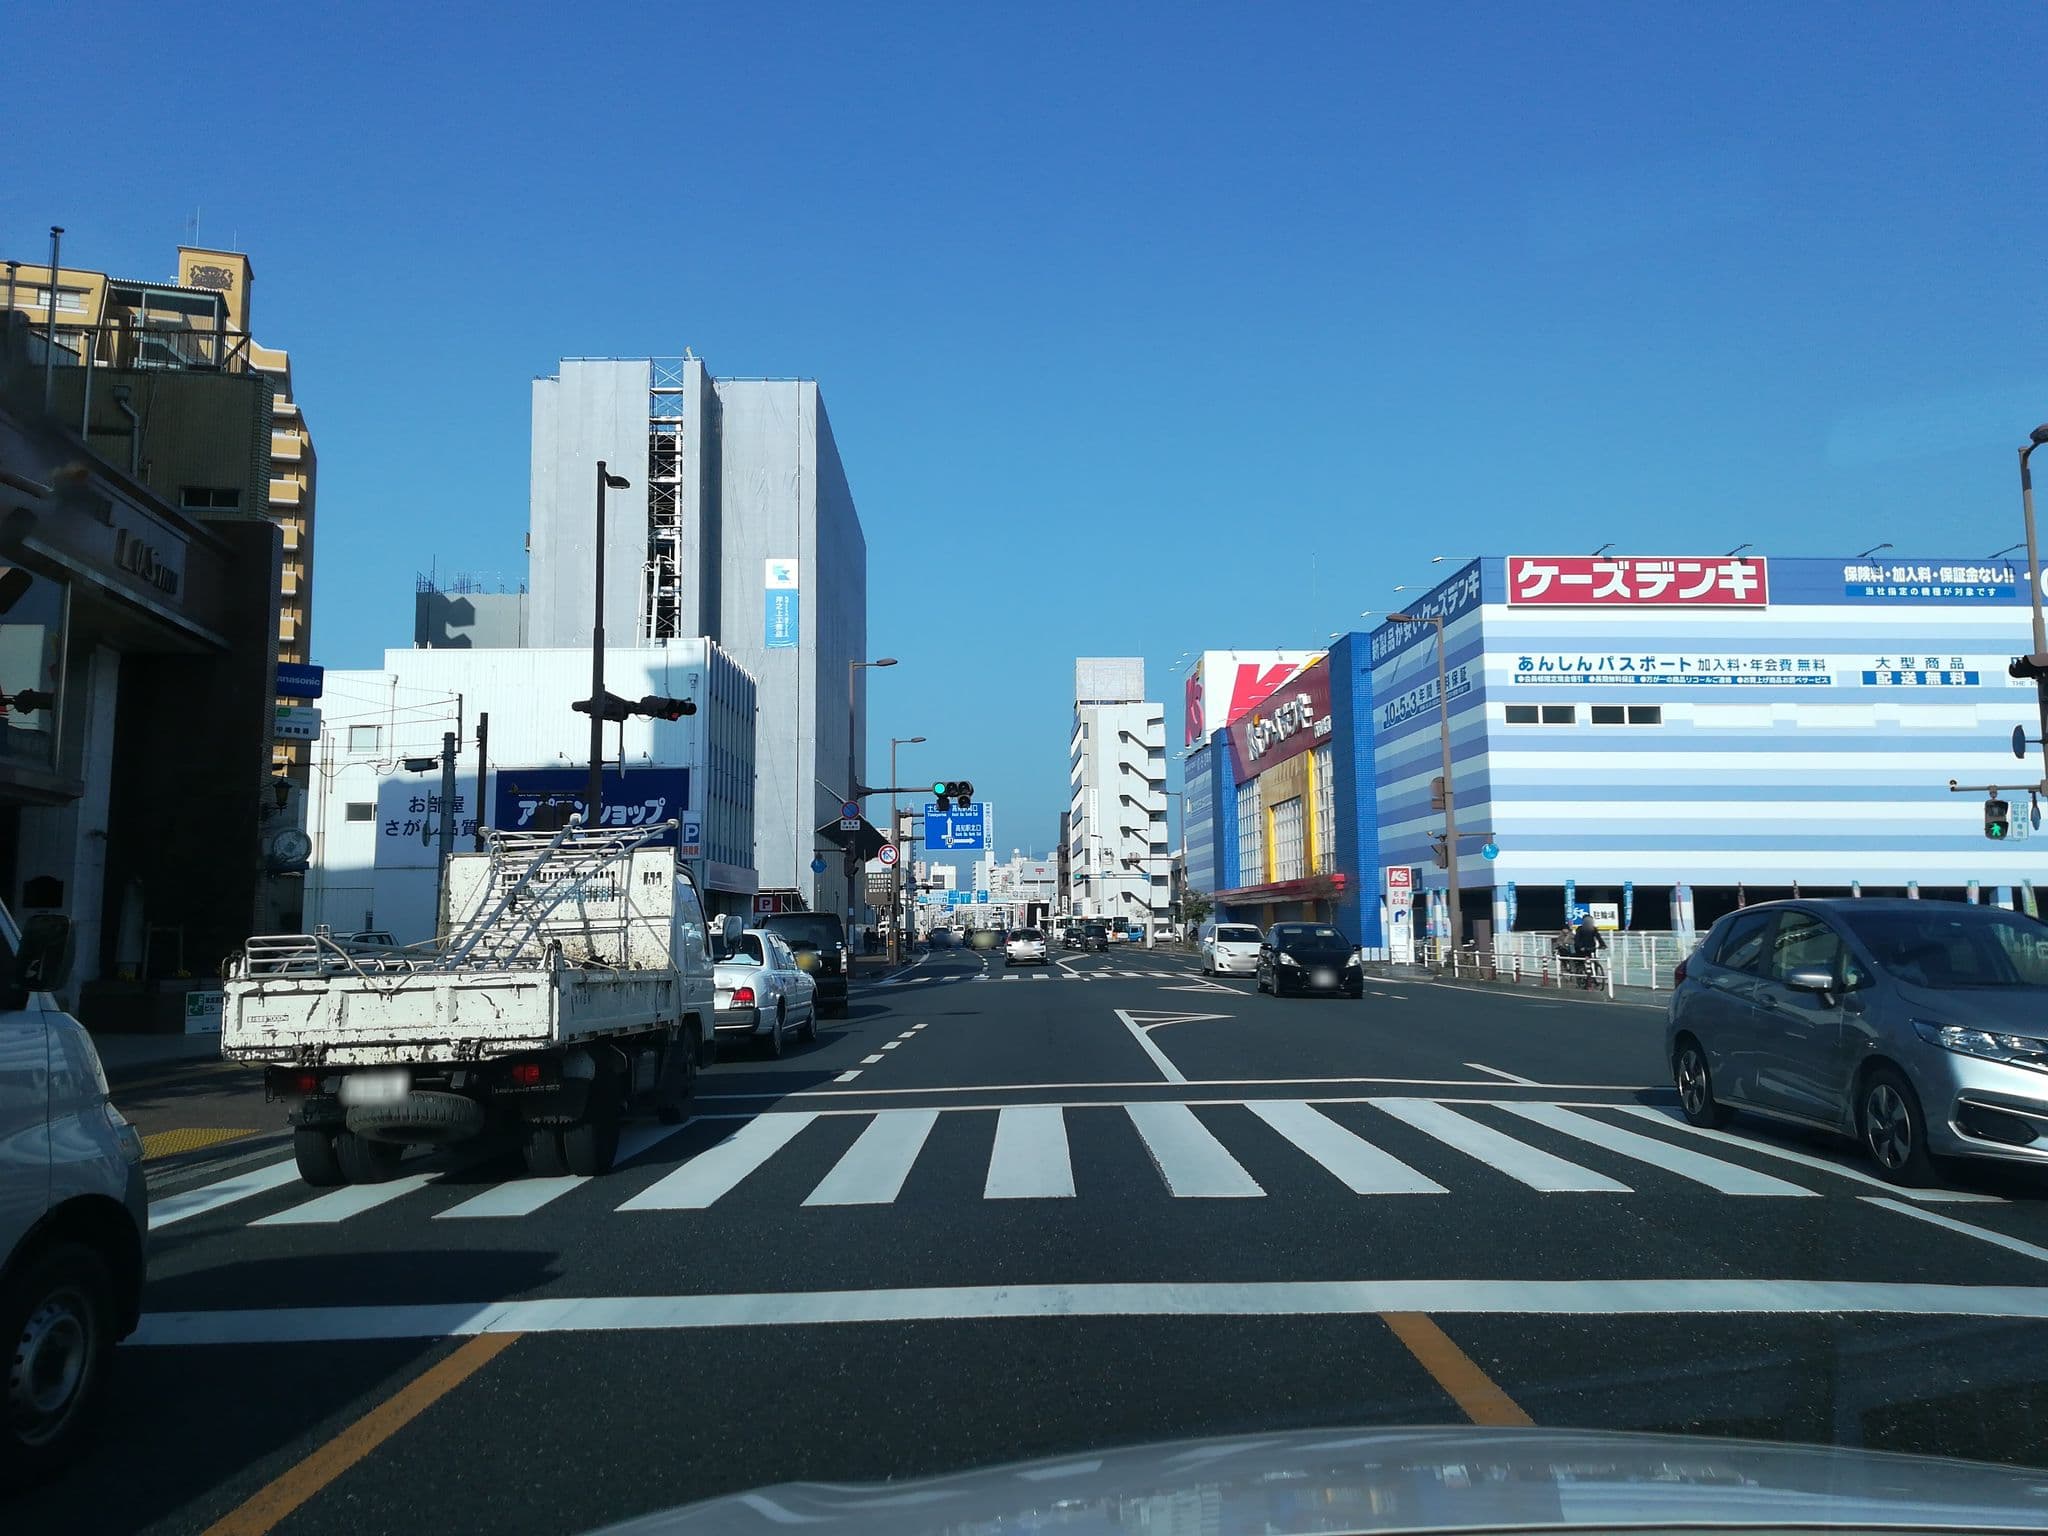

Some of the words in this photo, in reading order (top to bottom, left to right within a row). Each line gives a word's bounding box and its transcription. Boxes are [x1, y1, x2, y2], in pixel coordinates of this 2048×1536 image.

[1517, 560, 1758, 599] ケーズデンキ
[1518, 655, 1692, 672] あんしんパスポート
[1875, 656, 1965, 669] 大型商品
[276, 675, 321, 686] anasonic
[1875, 671, 1967, 685] 配送無料
[517, 796, 666, 826] アンョップ
[386, 819, 479, 837] さが質
[685, 824, 699, 842] P
[763, 900, 770, 909] P
